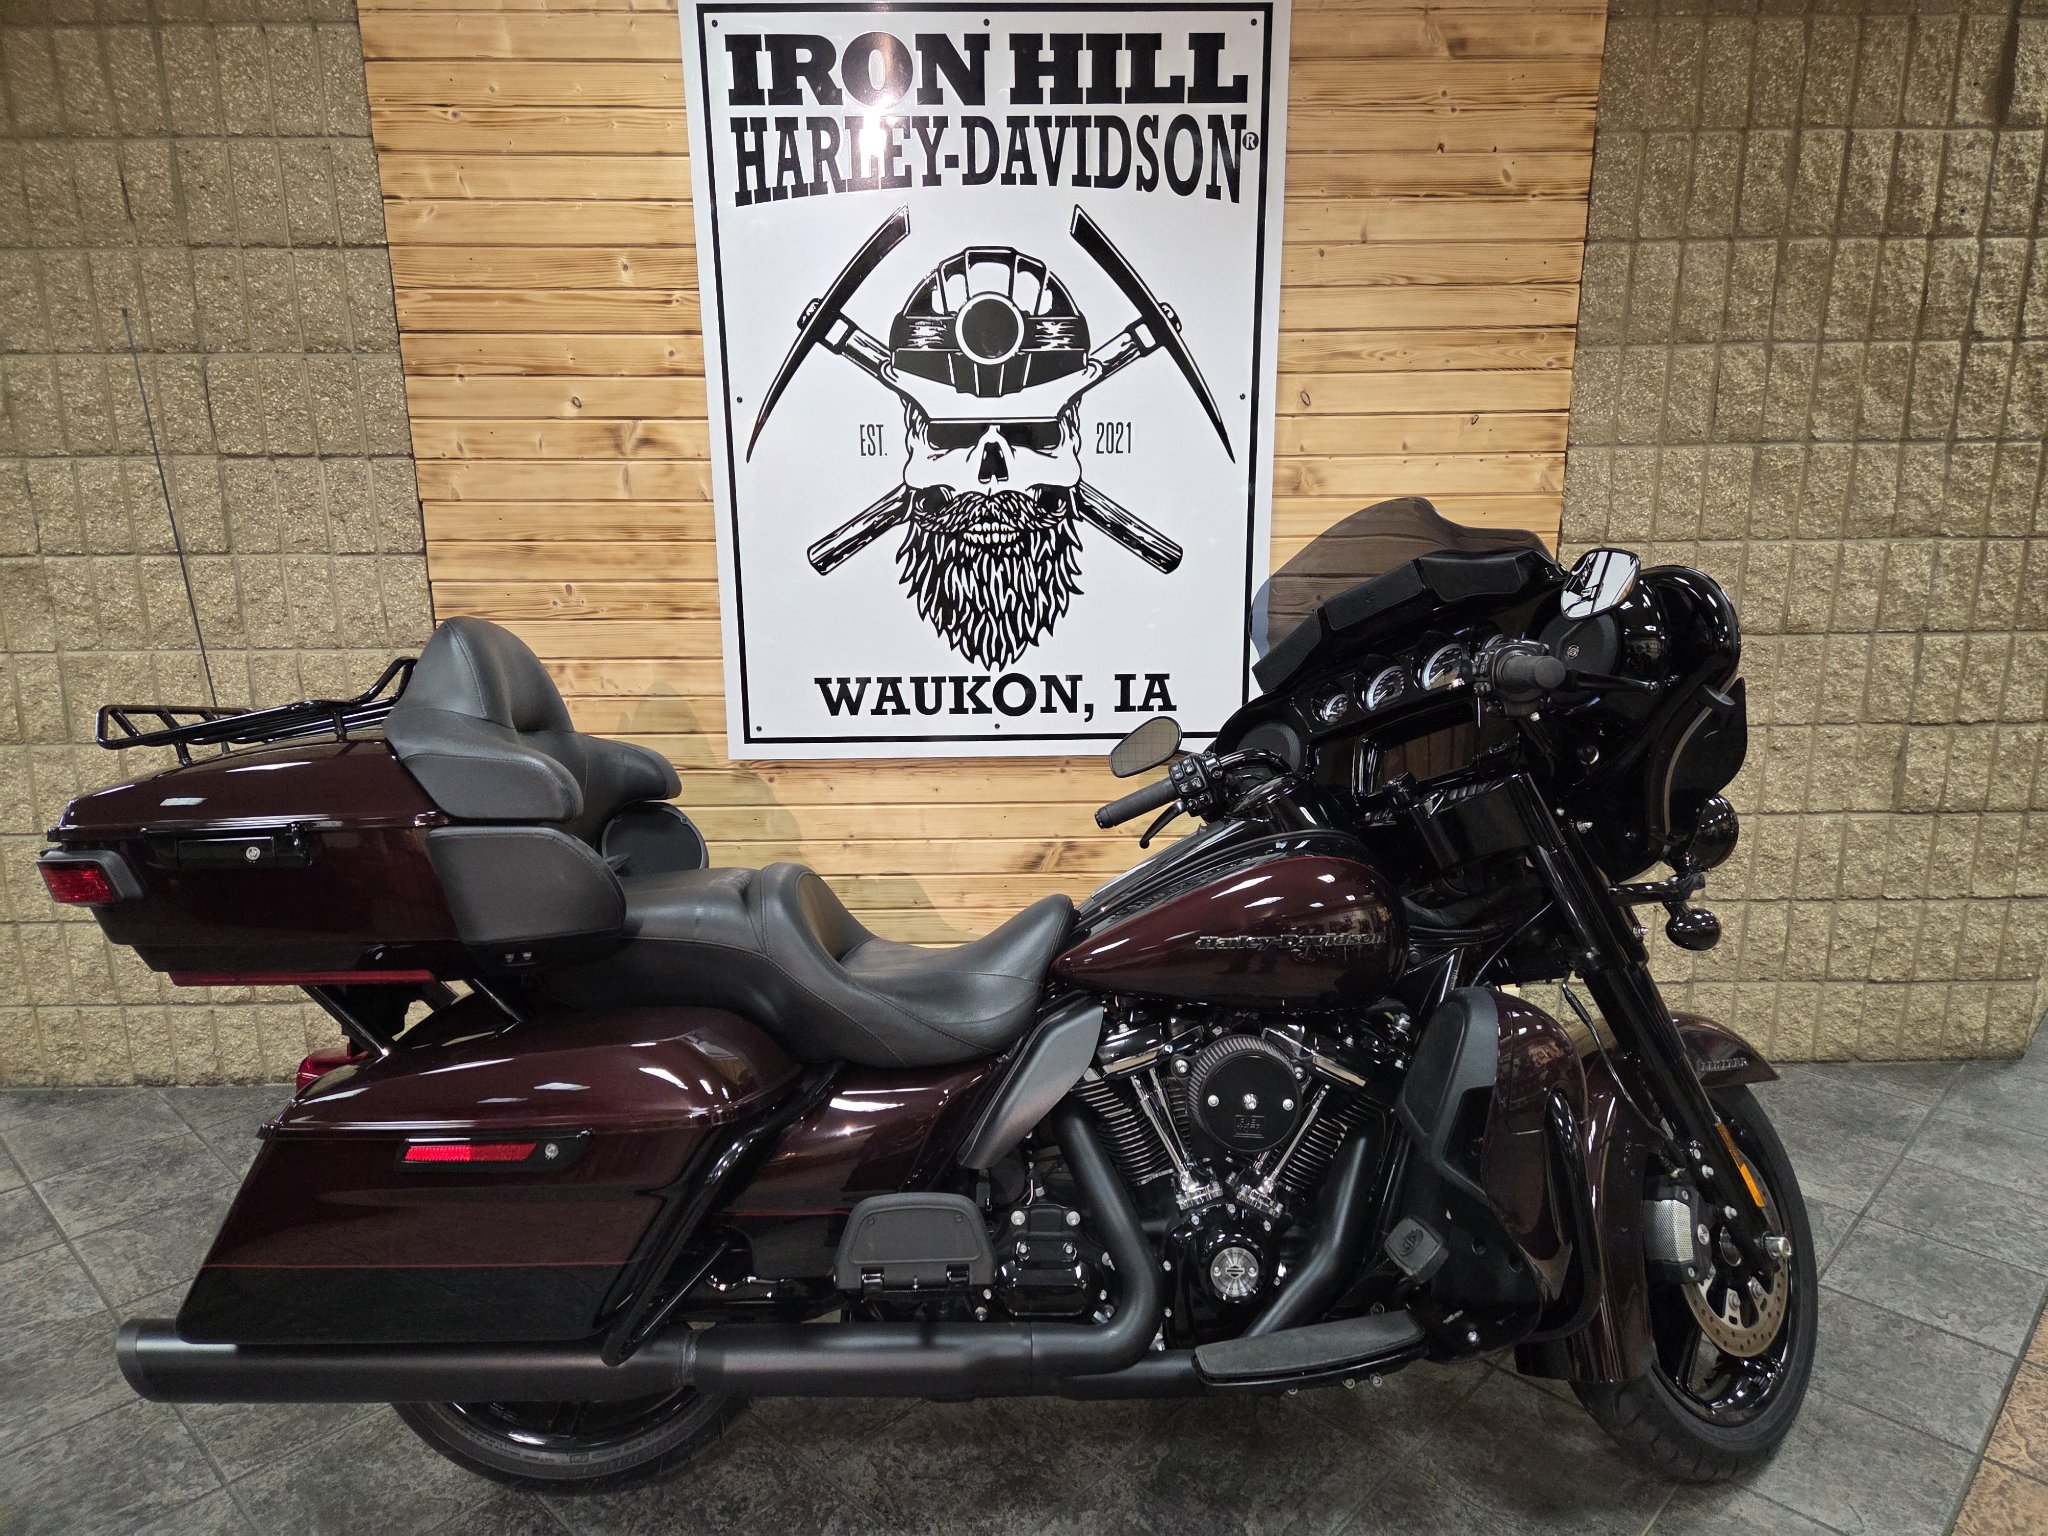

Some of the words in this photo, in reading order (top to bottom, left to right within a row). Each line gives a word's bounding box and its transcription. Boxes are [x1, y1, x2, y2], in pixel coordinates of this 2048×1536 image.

[724, 31, 990, 107] IRON
[1008, 32, 1249, 105] HILL
[860, 424, 888, 457] EST.
[1096, 422, 1132, 454] 2021
[814, 673, 1095, 722] WAUKON,
[1114, 673, 1177, 713] IA
